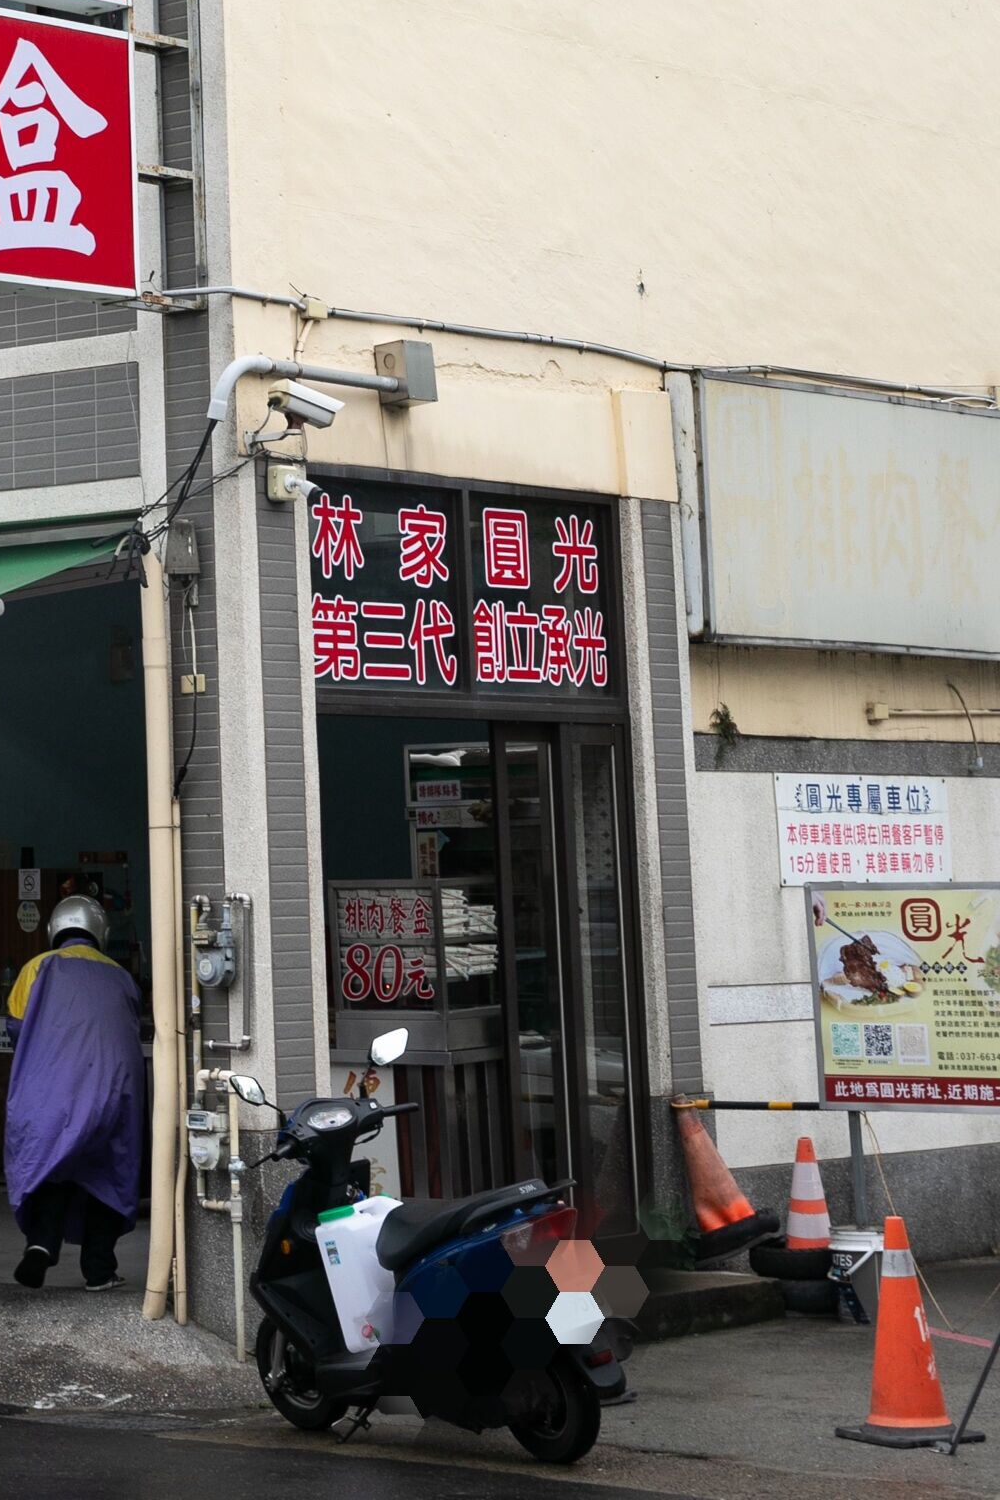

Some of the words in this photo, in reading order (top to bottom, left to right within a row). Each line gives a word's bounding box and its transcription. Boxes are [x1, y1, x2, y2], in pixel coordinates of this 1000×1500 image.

[312, 492, 599, 595] 林家圓光
[805, 783, 923, 815] 圓光專屬車位
[900, 897, 986, 964] 圓光
[341, 943, 436, 1003] 80元
